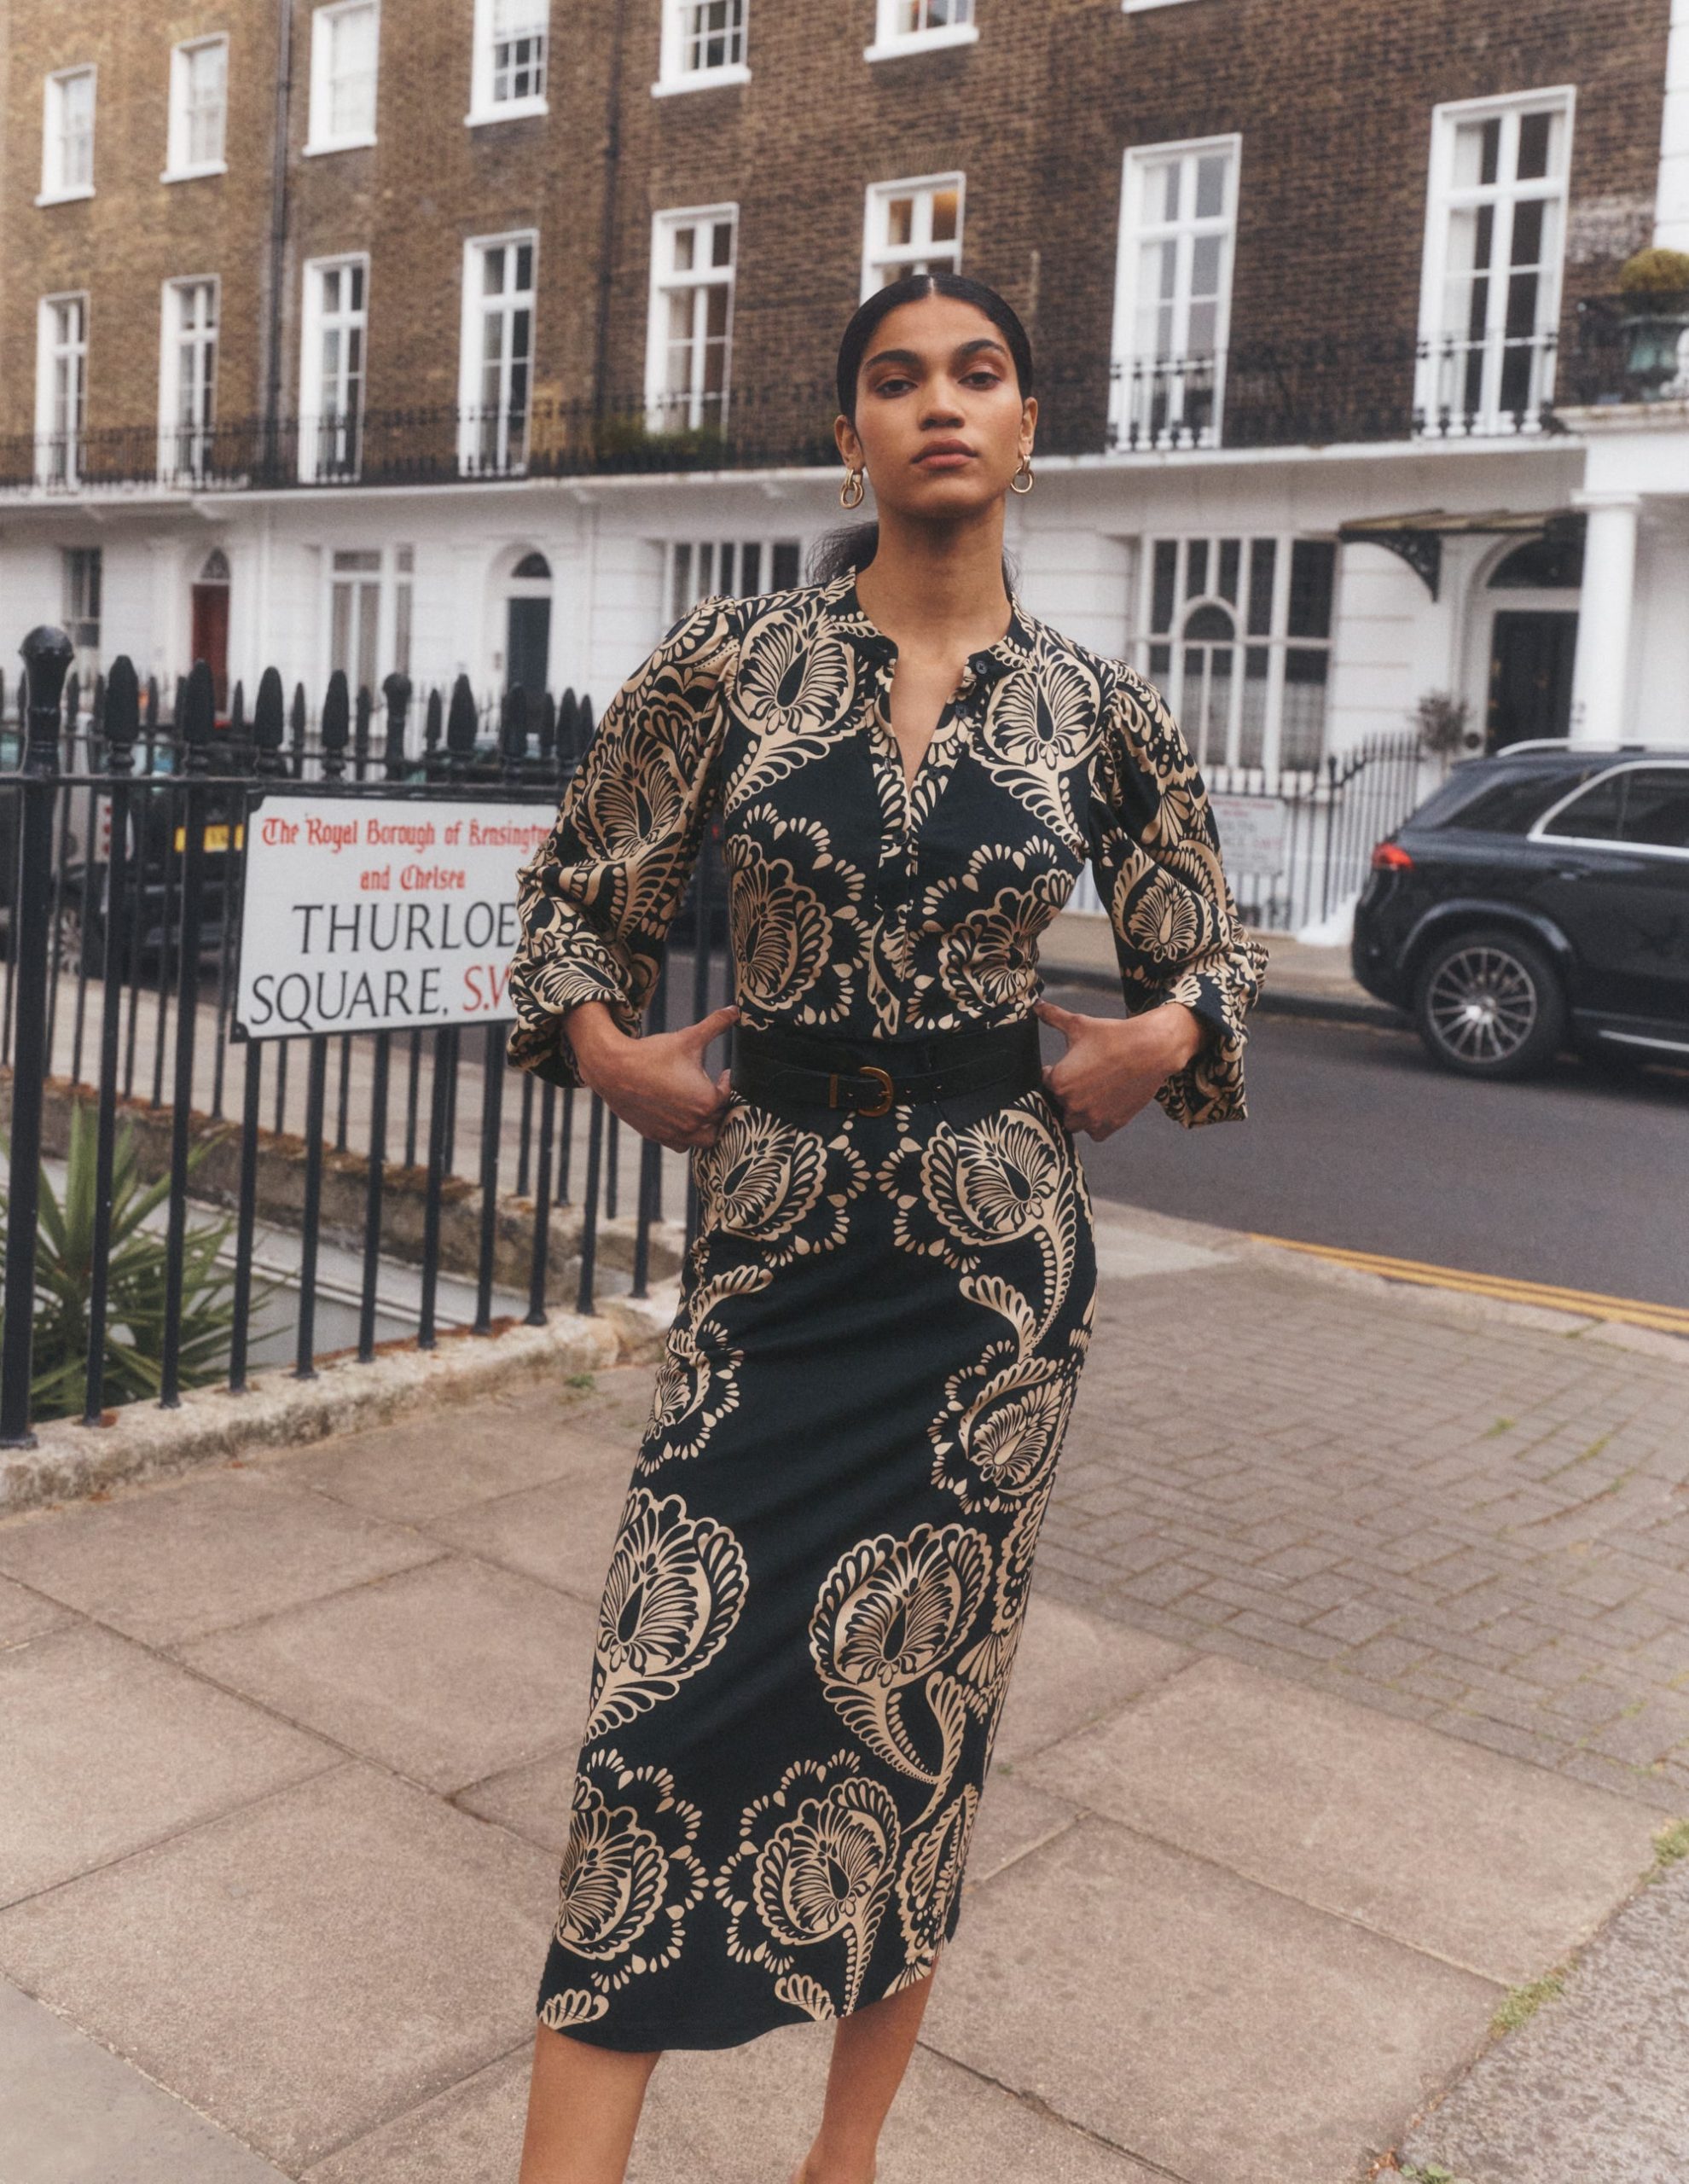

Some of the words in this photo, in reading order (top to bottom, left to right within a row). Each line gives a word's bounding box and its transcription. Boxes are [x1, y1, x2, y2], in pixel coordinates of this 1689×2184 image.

[261, 817, 299, 845] The
[305, 817, 358, 853] Royal
[366, 818, 435, 853] Borough
[444, 821, 461, 846] of
[360, 865, 390, 891] and
[400, 864, 466, 891] Chelsea
[292, 901, 517, 955] THURLOE
